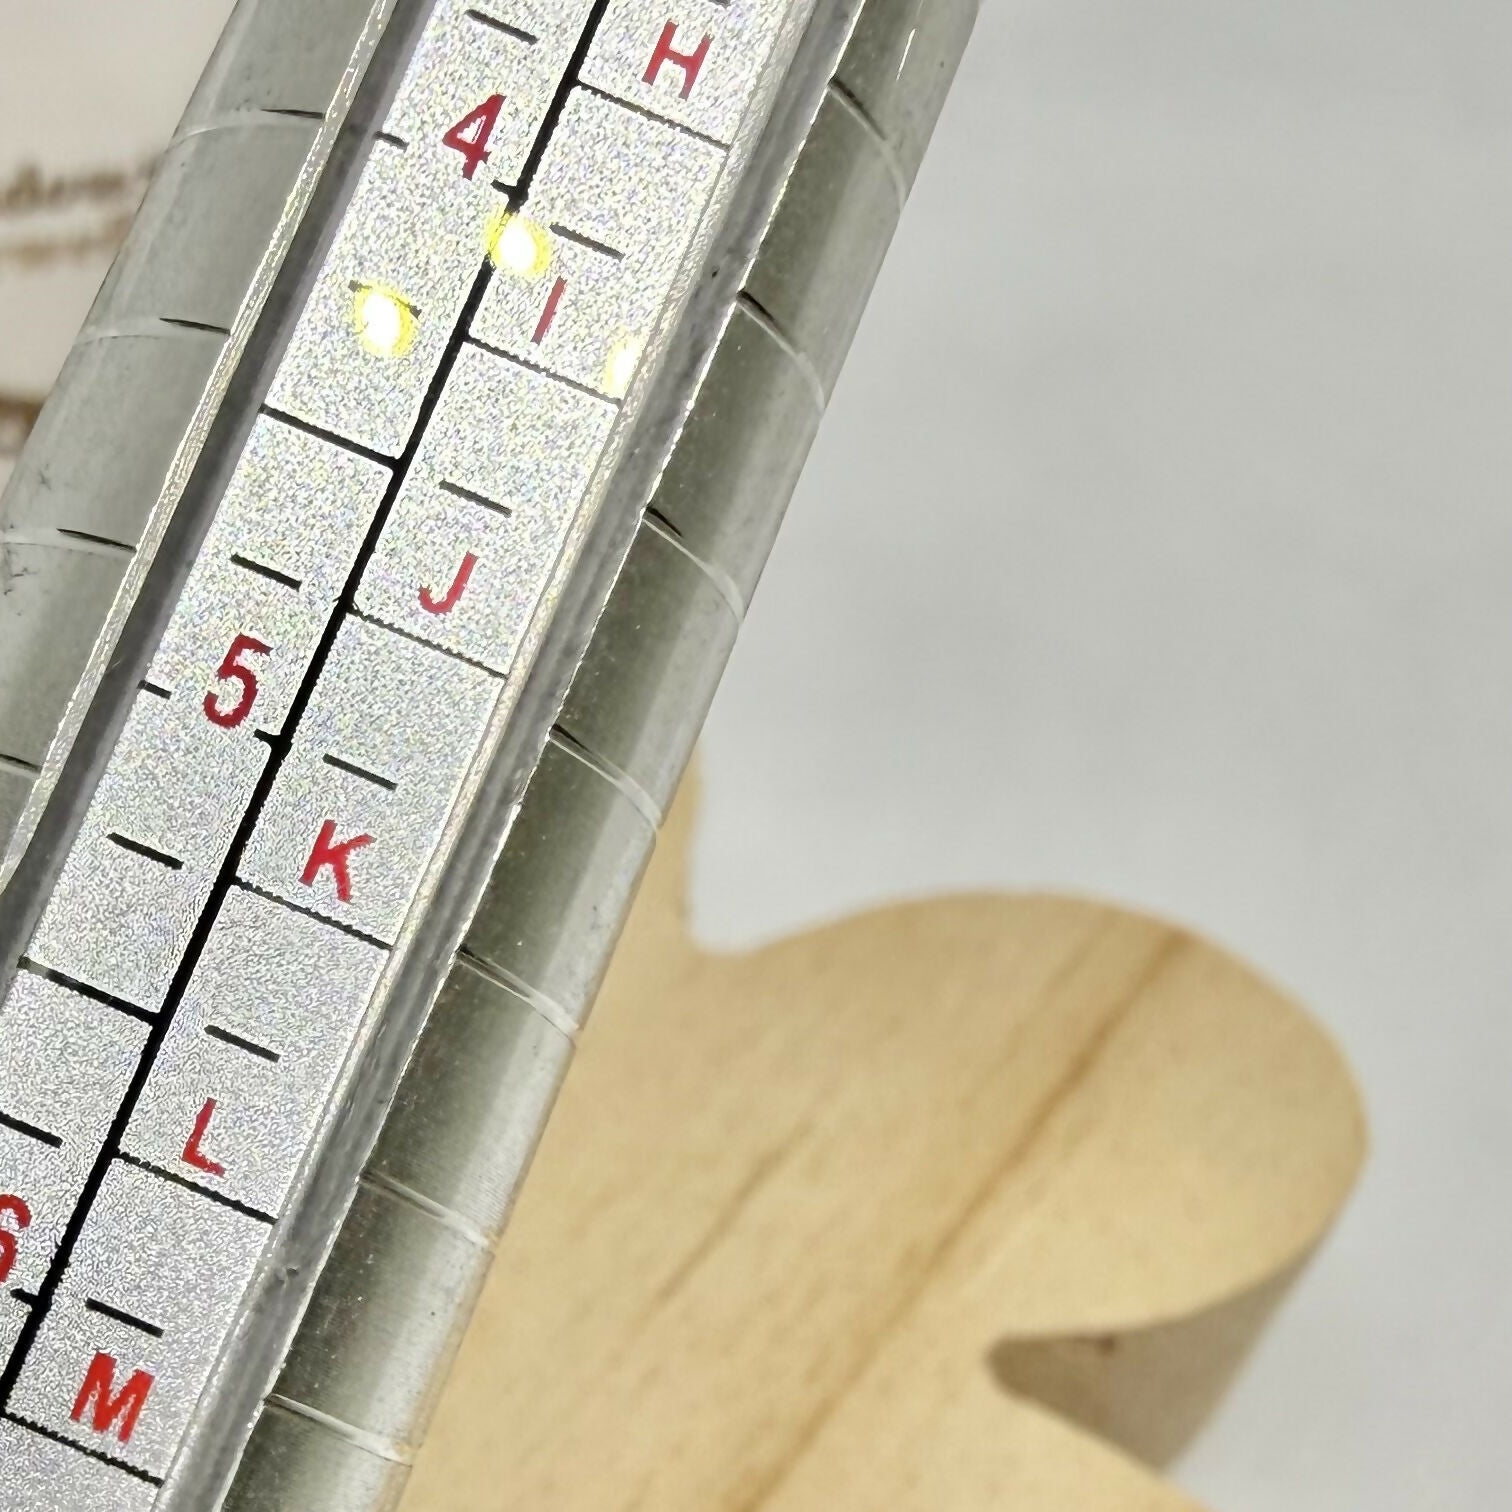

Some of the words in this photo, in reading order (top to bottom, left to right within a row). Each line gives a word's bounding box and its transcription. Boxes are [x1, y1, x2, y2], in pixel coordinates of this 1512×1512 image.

[643, 19, 712, 99] H
[442, 94, 506, 180] 4
[532, 277, 567, 345] I
[419, 552, 478, 615] J
[203, 635, 271, 728] 5
[301, 821, 370, 901] K
[182, 1100, 224, 1174] L
[71, 1353, 153, 1443] M
